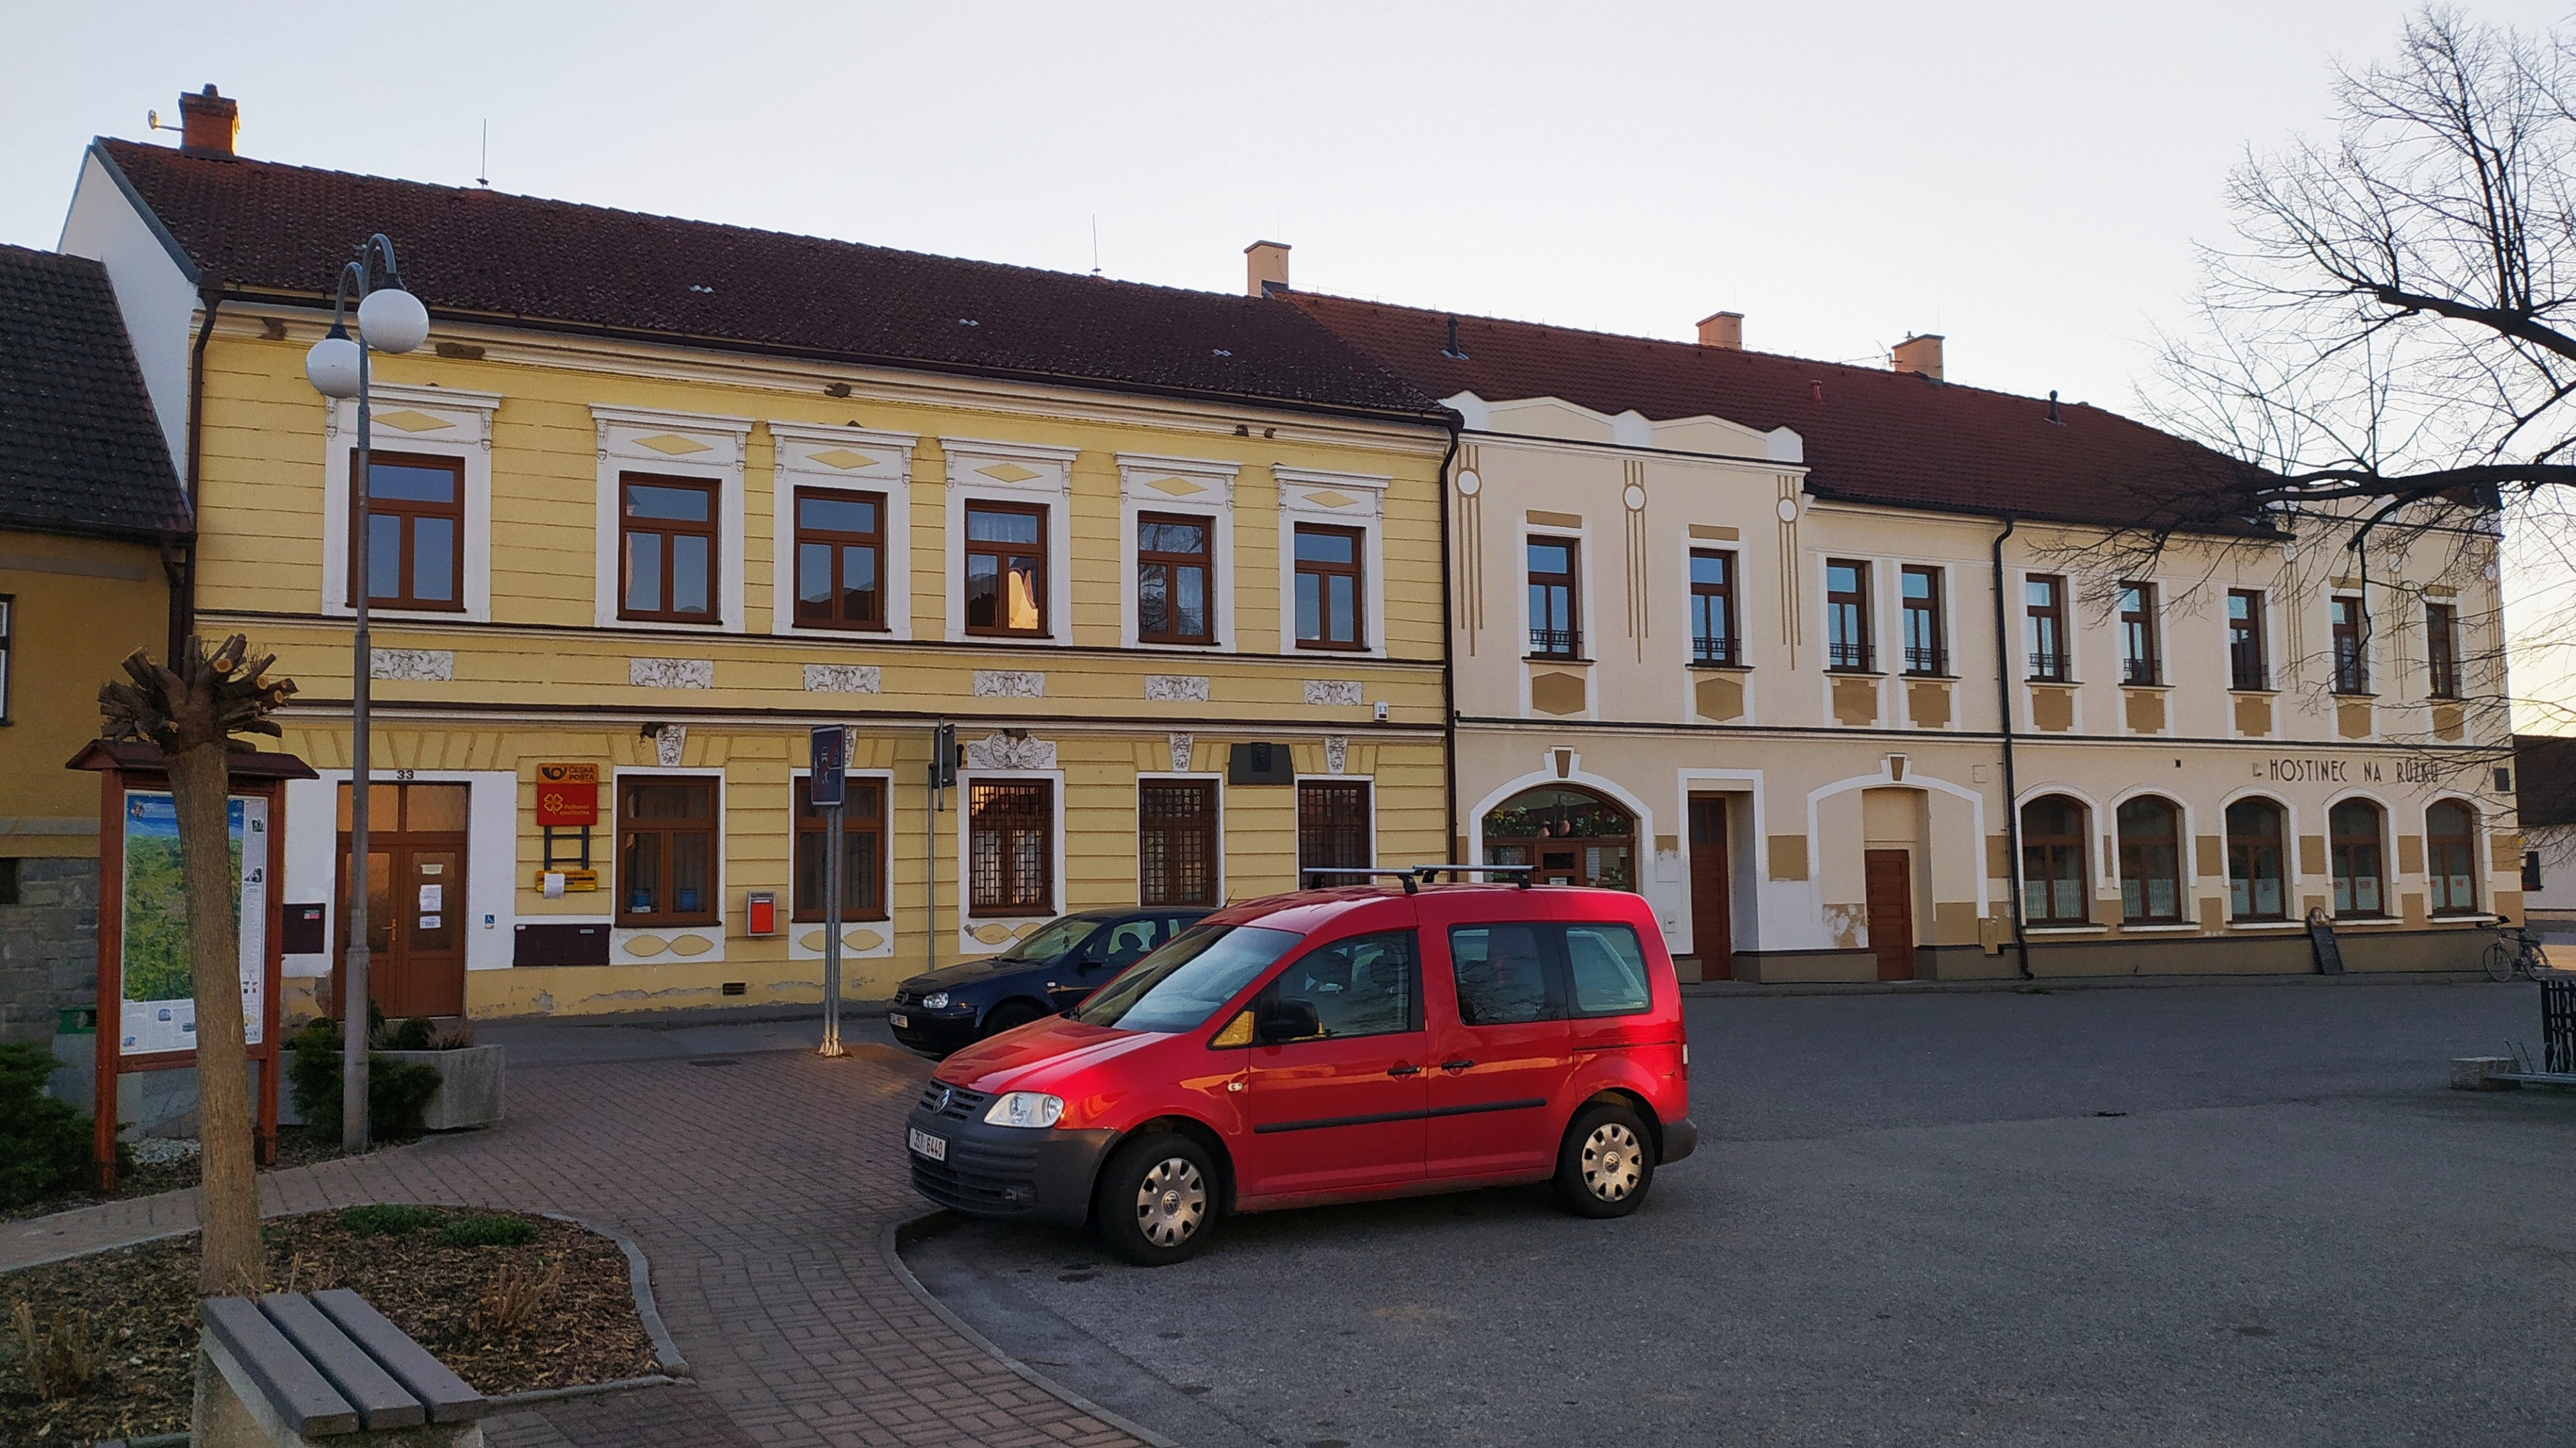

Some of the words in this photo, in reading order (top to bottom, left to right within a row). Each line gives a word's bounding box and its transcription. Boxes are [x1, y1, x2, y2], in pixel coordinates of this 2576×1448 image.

[397, 769, 414, 780] 33
[2269, 759, 2347, 782] HOSTINEC
[2363, 762, 2382, 782] NA
[926, 1137, 942, 1158] 6440
